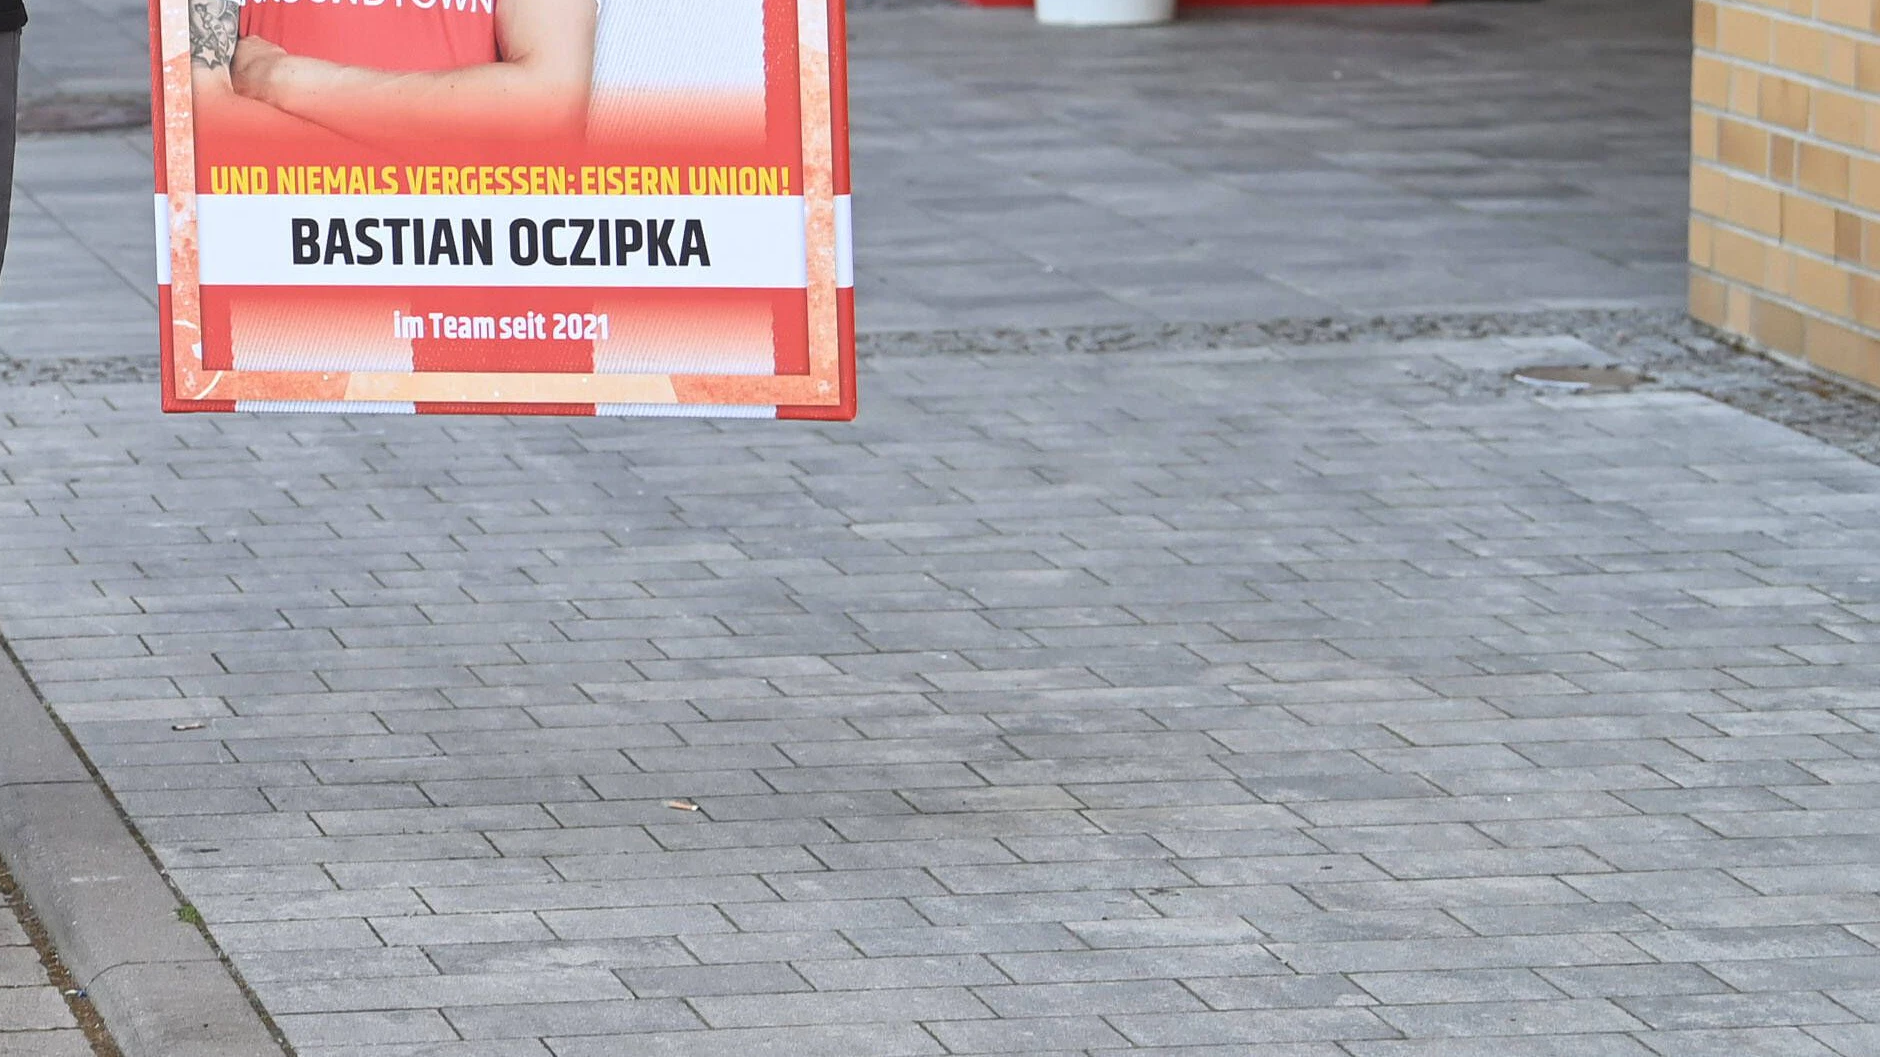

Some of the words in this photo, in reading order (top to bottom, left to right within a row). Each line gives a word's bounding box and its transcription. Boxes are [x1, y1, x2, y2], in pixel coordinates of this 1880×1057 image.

[209, 165, 269, 195] UND
[276, 165, 400, 195] NIEMALS
[405, 165, 577, 195] VERGESSEN:
[580, 166, 680, 196] EISERN
[688, 166, 790, 196] UNION!
[291, 218, 494, 266] BASTIAN
[508, 218, 712, 267] OCZIPKA
[393, 310, 424, 338] im
[428, 312, 495, 340] Team
[500, 311, 547, 340] seit
[552, 313, 610, 341] 2021
